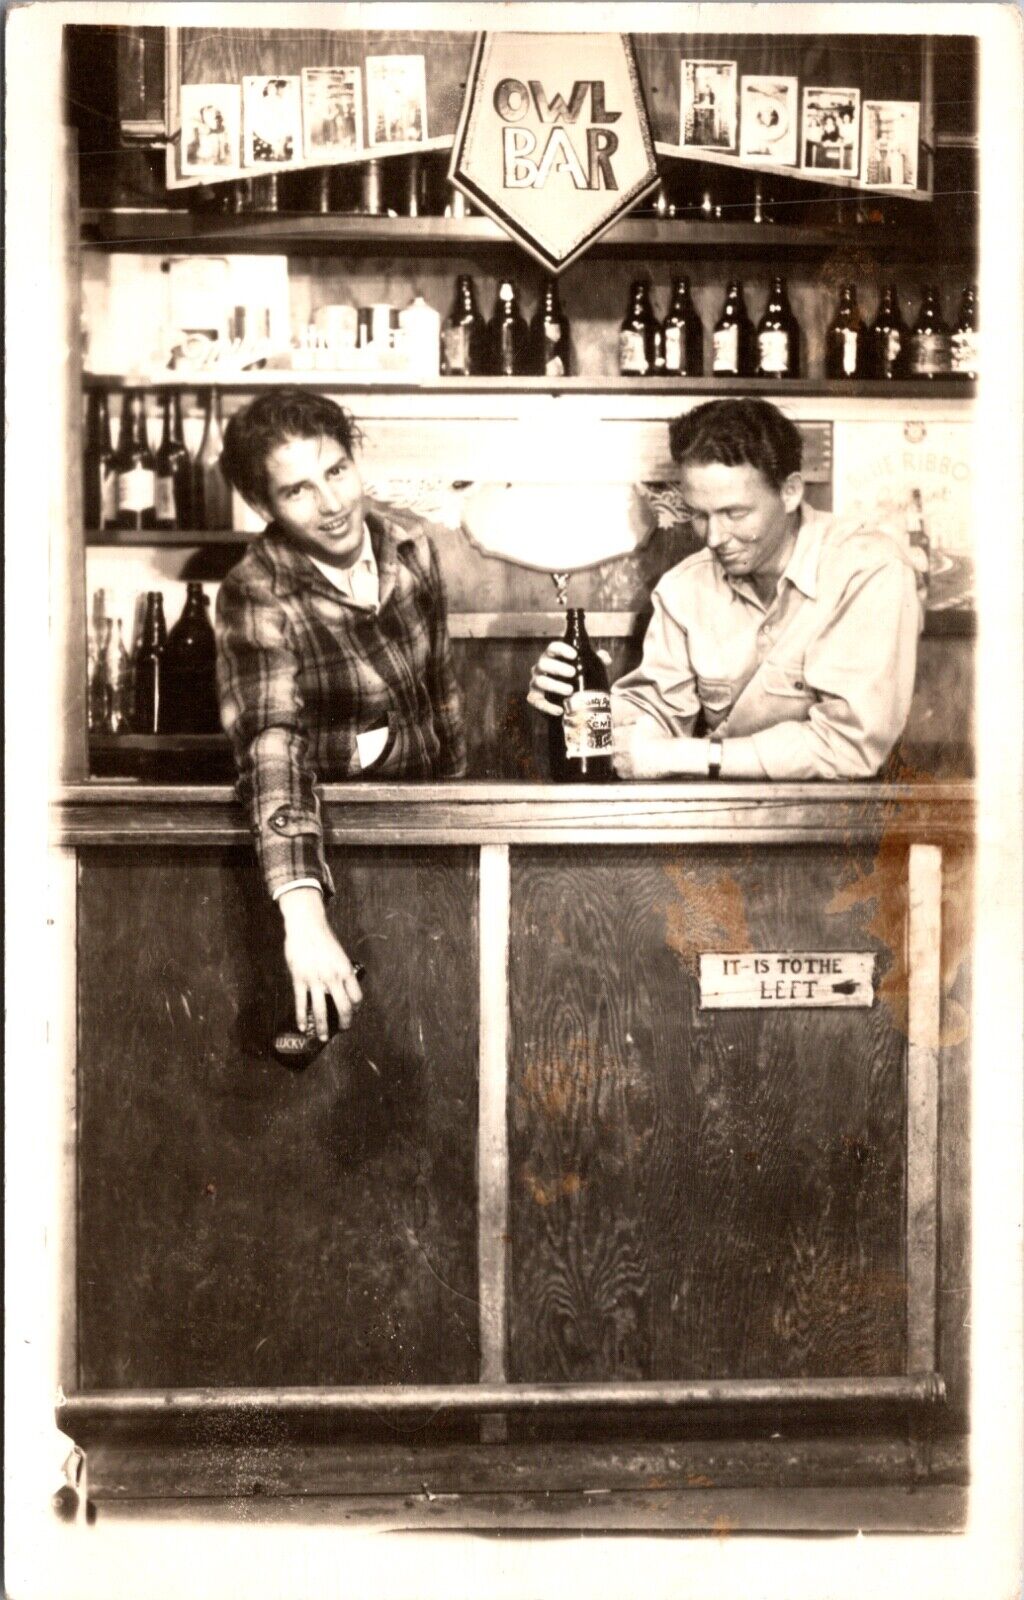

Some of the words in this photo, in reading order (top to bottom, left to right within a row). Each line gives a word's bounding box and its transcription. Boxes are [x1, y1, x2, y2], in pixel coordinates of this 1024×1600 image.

[493, 78, 622, 124] OWL
[502, 126, 619, 191] BAR
[760, 980, 818, 1000] LEFT
